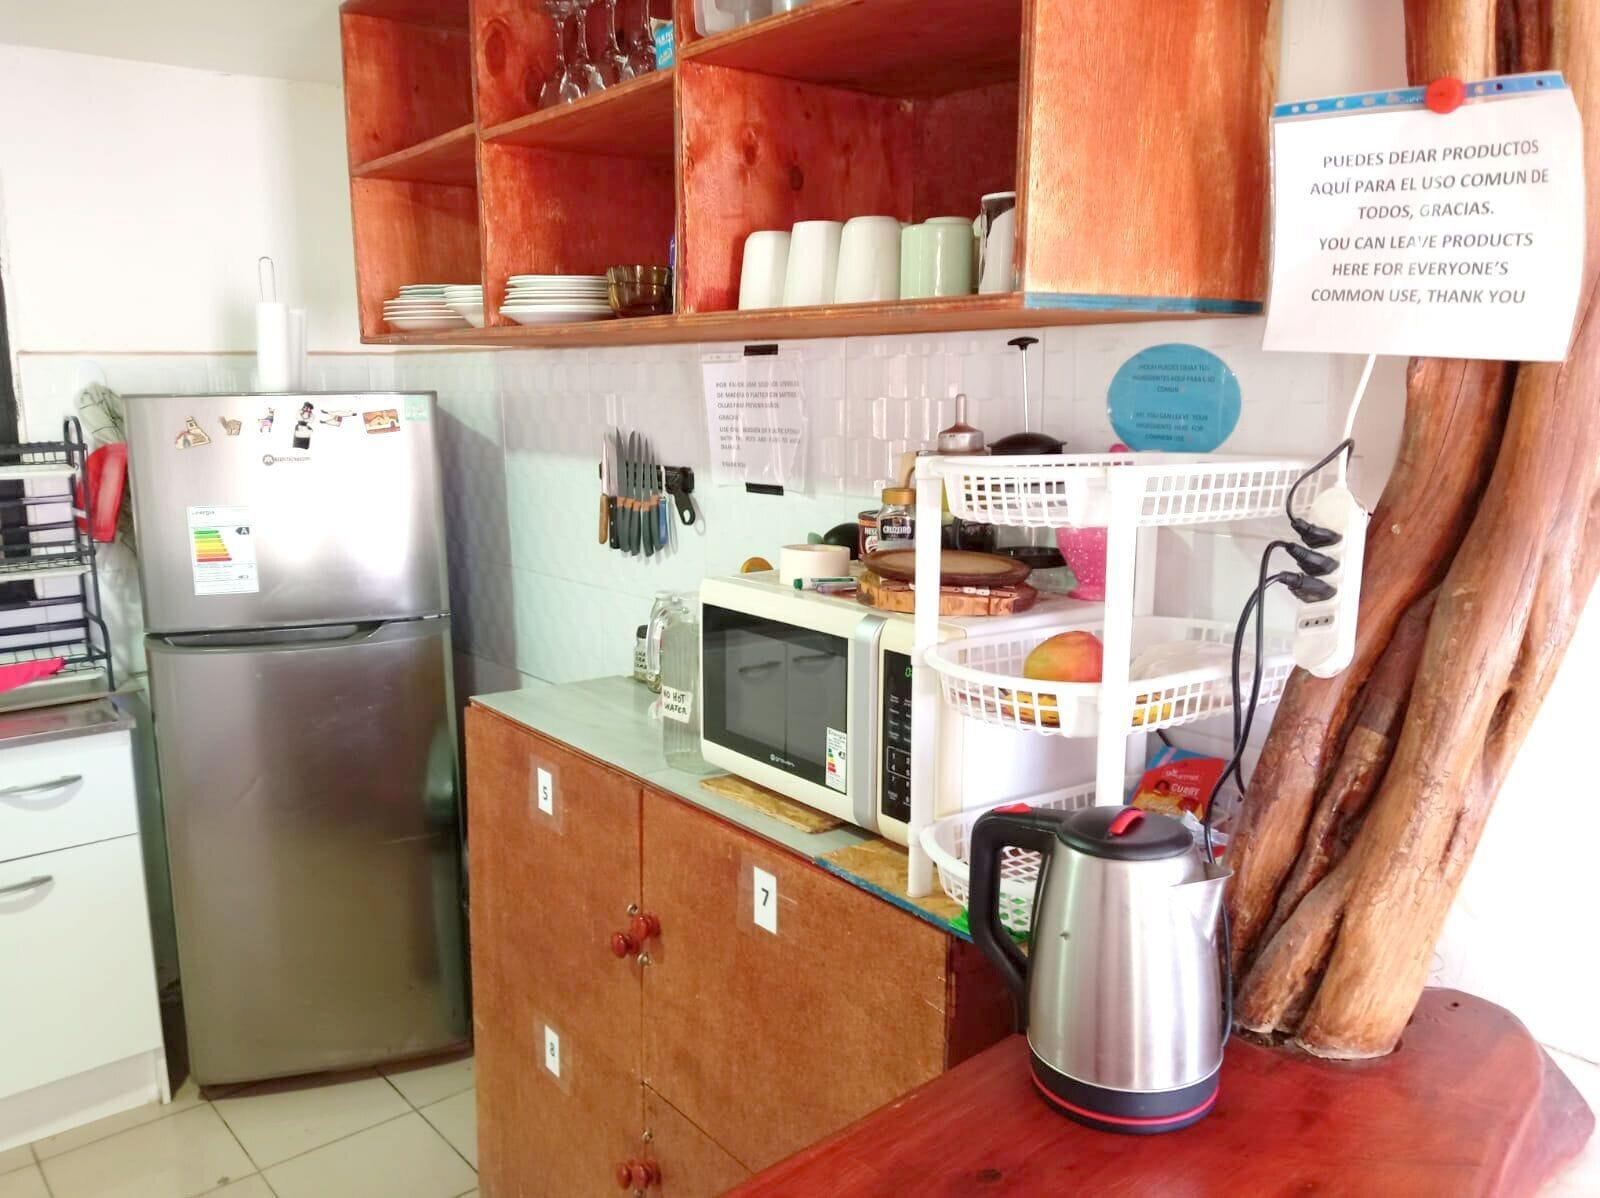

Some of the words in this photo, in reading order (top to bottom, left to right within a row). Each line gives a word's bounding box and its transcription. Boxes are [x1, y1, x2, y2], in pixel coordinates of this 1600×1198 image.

[1323, 152, 1384, 168] PUEDES
[1388, 148, 1437, 165] DEJAR
[1442, 139, 1539, 161] PRODUCTOS
[1310, 177, 1351, 196] AQUÍ
[1354, 178, 1397, 193] PARA
[1400, 177, 1417, 191] EL
[1421, 174, 1456, 190] USO
[1460, 171, 1527, 188] COMUN
[1531, 168, 1549, 184] DE
[1358, 204, 1414, 220] TODOS,
[1419, 200, 1494, 217] GRACIAS.
[1319, 237, 1351, 251] YOU
[1354, 236, 1386, 250] CAN
[1390, 234, 1438, 249] LEAVE
[1442, 232, 1533, 248] PRODUCTS
[1332, 263, 1370, 276] HERE
[1373, 262, 1404, 276] FOR
[1311, 288, 1385, 302] COMMON
[1388, 288, 1421, 305] USE,
[1427, 289, 1484, 303] THANK
[1488, 289, 1526, 304] YOU
[543, 785, 549, 801] 5
[1171, 783, 1201, 797] CURRY
[761, 887, 769, 907] 7
